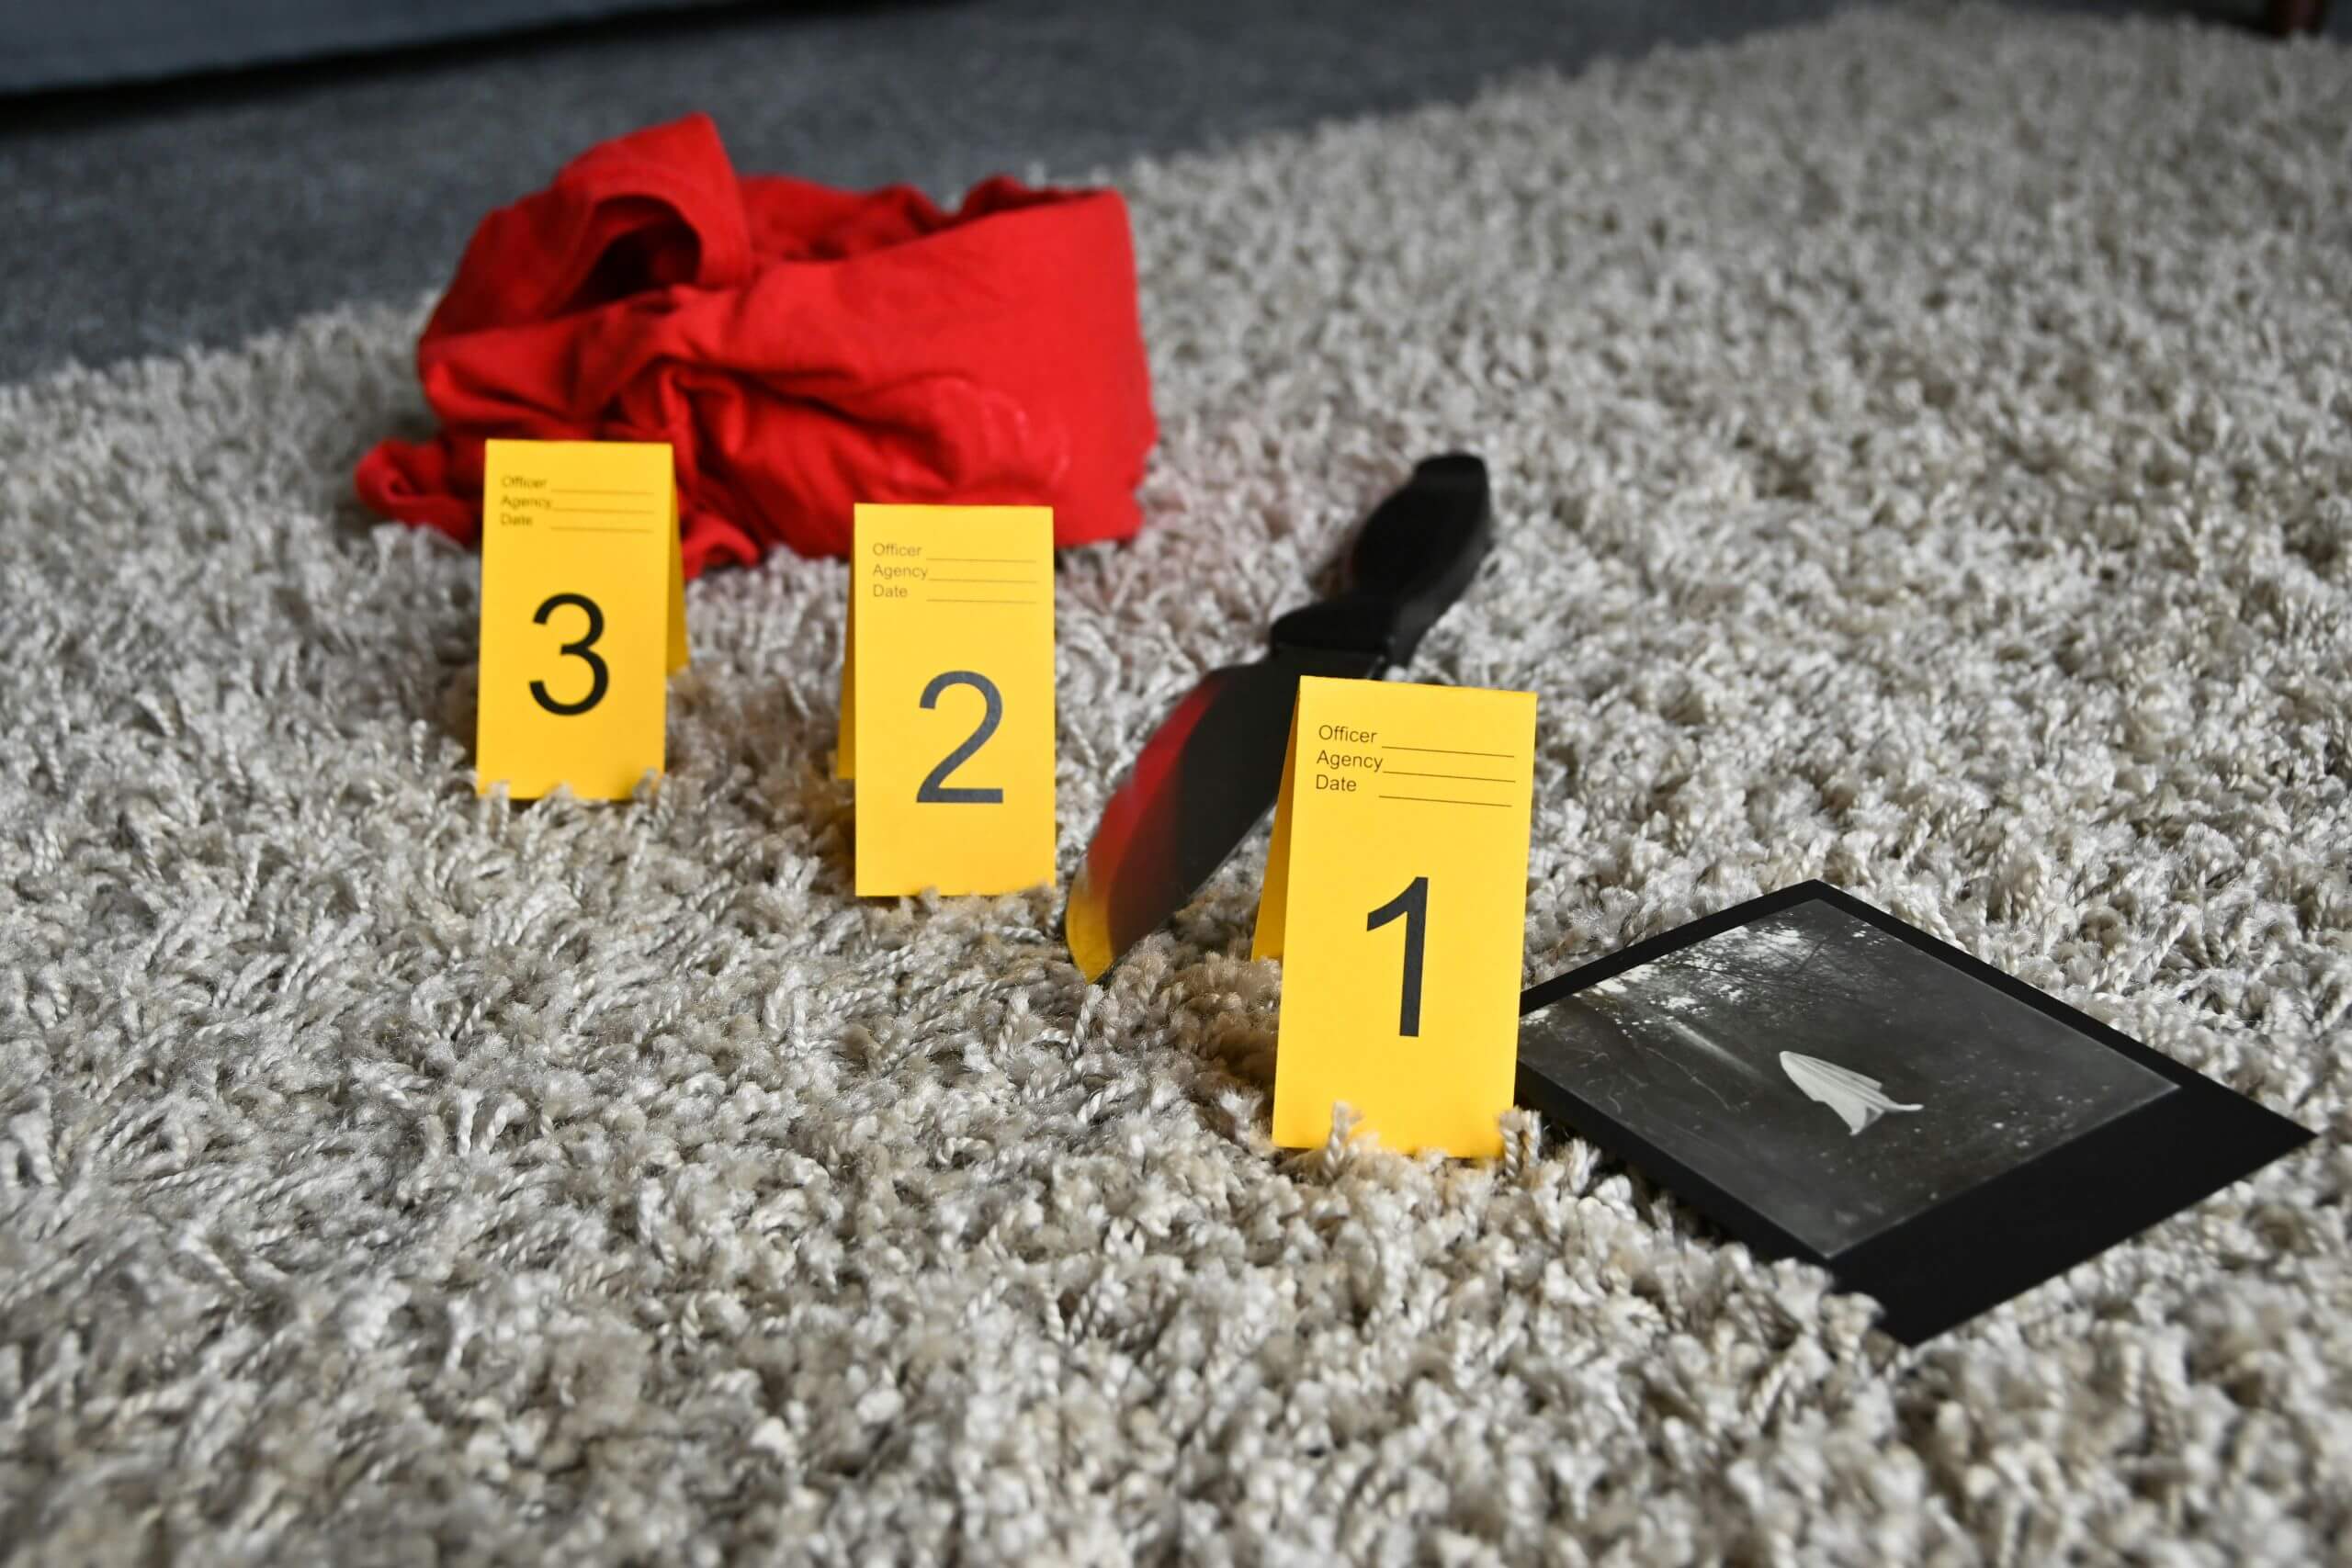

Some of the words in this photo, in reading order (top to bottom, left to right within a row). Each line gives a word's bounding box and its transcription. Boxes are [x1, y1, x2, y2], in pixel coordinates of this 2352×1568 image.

[501, 475, 548, 489] Officer
[501, 495, 552, 509] Agency
[501, 514, 533, 526] Date
[873, 543, 922, 557] Officer
[873, 563, 928, 581] Agency
[873, 583, 909, 598] Date
[529, 592, 608, 716] 3
[917, 671, 1003, 804] 2
[1318, 724, 1378, 743] Officer
[1317, 750, 1384, 772] Agency
[1316, 773, 1357, 792] Date
[1366, 876, 1429, 1037] 1
